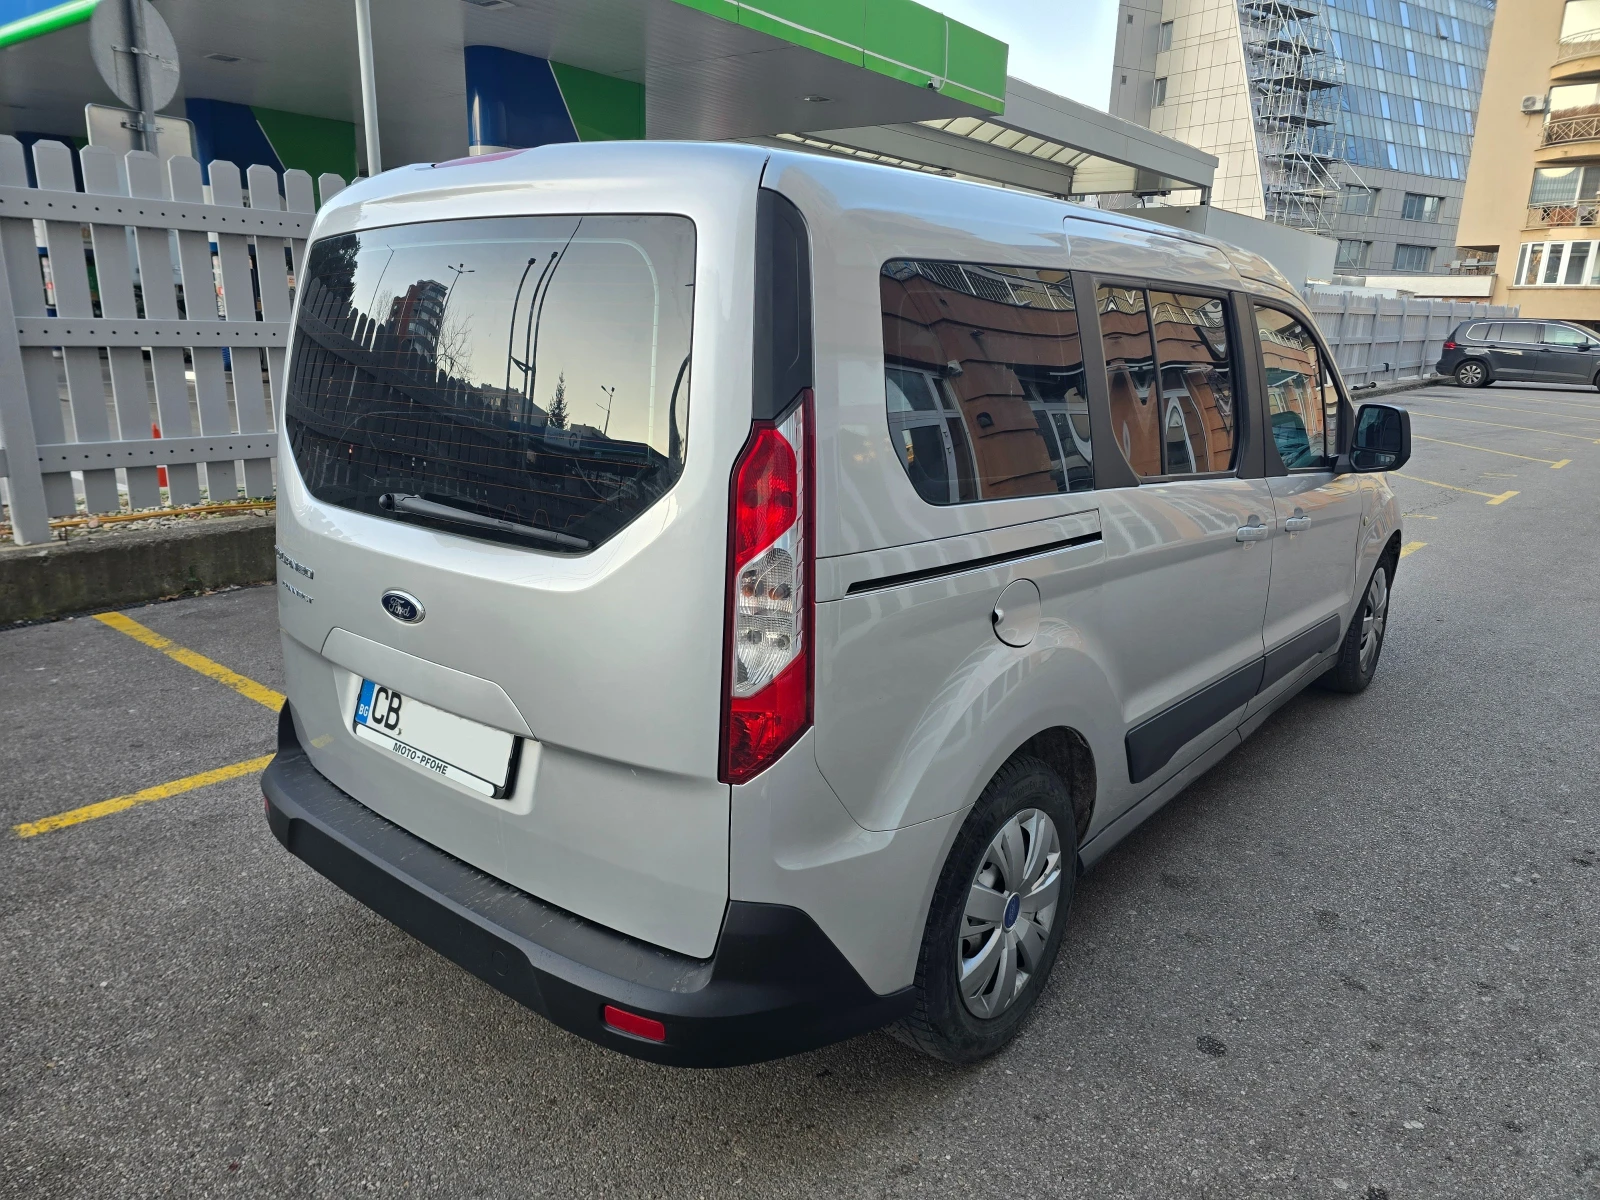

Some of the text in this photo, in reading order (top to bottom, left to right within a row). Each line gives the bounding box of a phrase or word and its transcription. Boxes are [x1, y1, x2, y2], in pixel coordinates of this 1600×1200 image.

[388, 596, 411, 617] Ford
[358, 703, 369, 717] BG
[392, 742, 449, 775] MOTO-PFOHE
